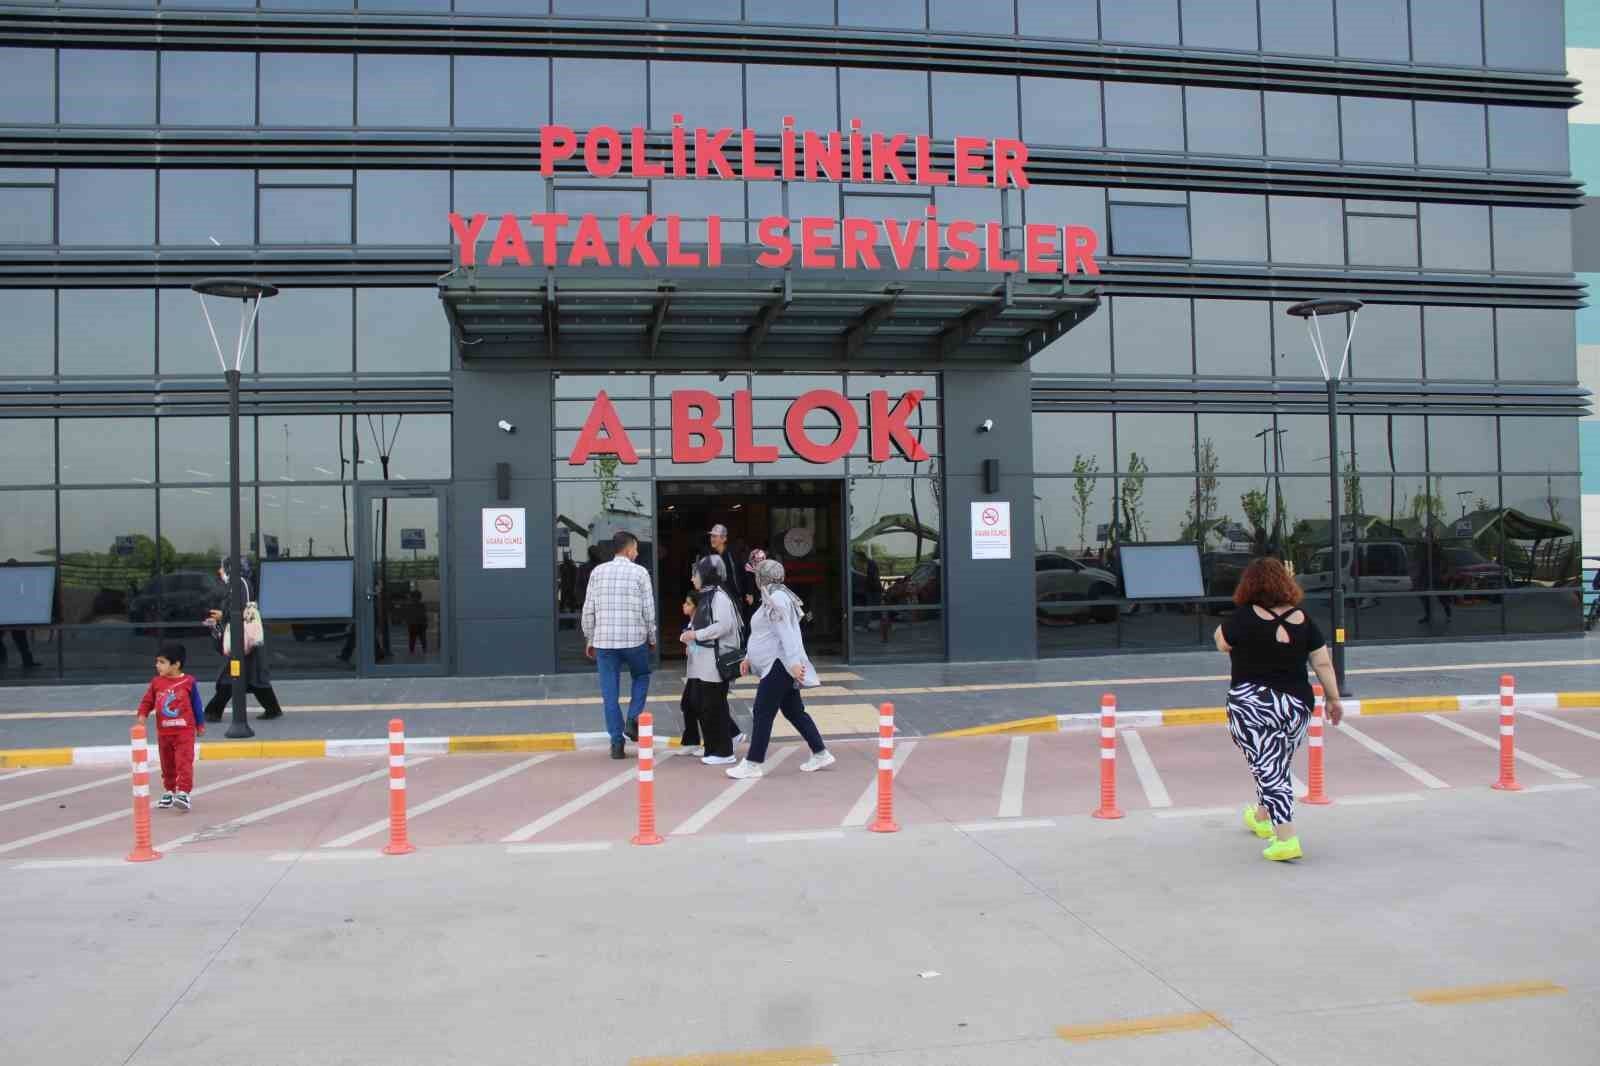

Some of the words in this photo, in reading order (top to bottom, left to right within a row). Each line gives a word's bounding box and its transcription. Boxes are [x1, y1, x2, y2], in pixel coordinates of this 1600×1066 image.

[538, 113, 1030, 189] POLİKLİNİKLER
[447, 212, 722, 267] YATAKLI
[756, 204, 1101, 276] SERVİSLER
[568, 389, 640, 466] A
[670, 388, 931, 465] BLOK
